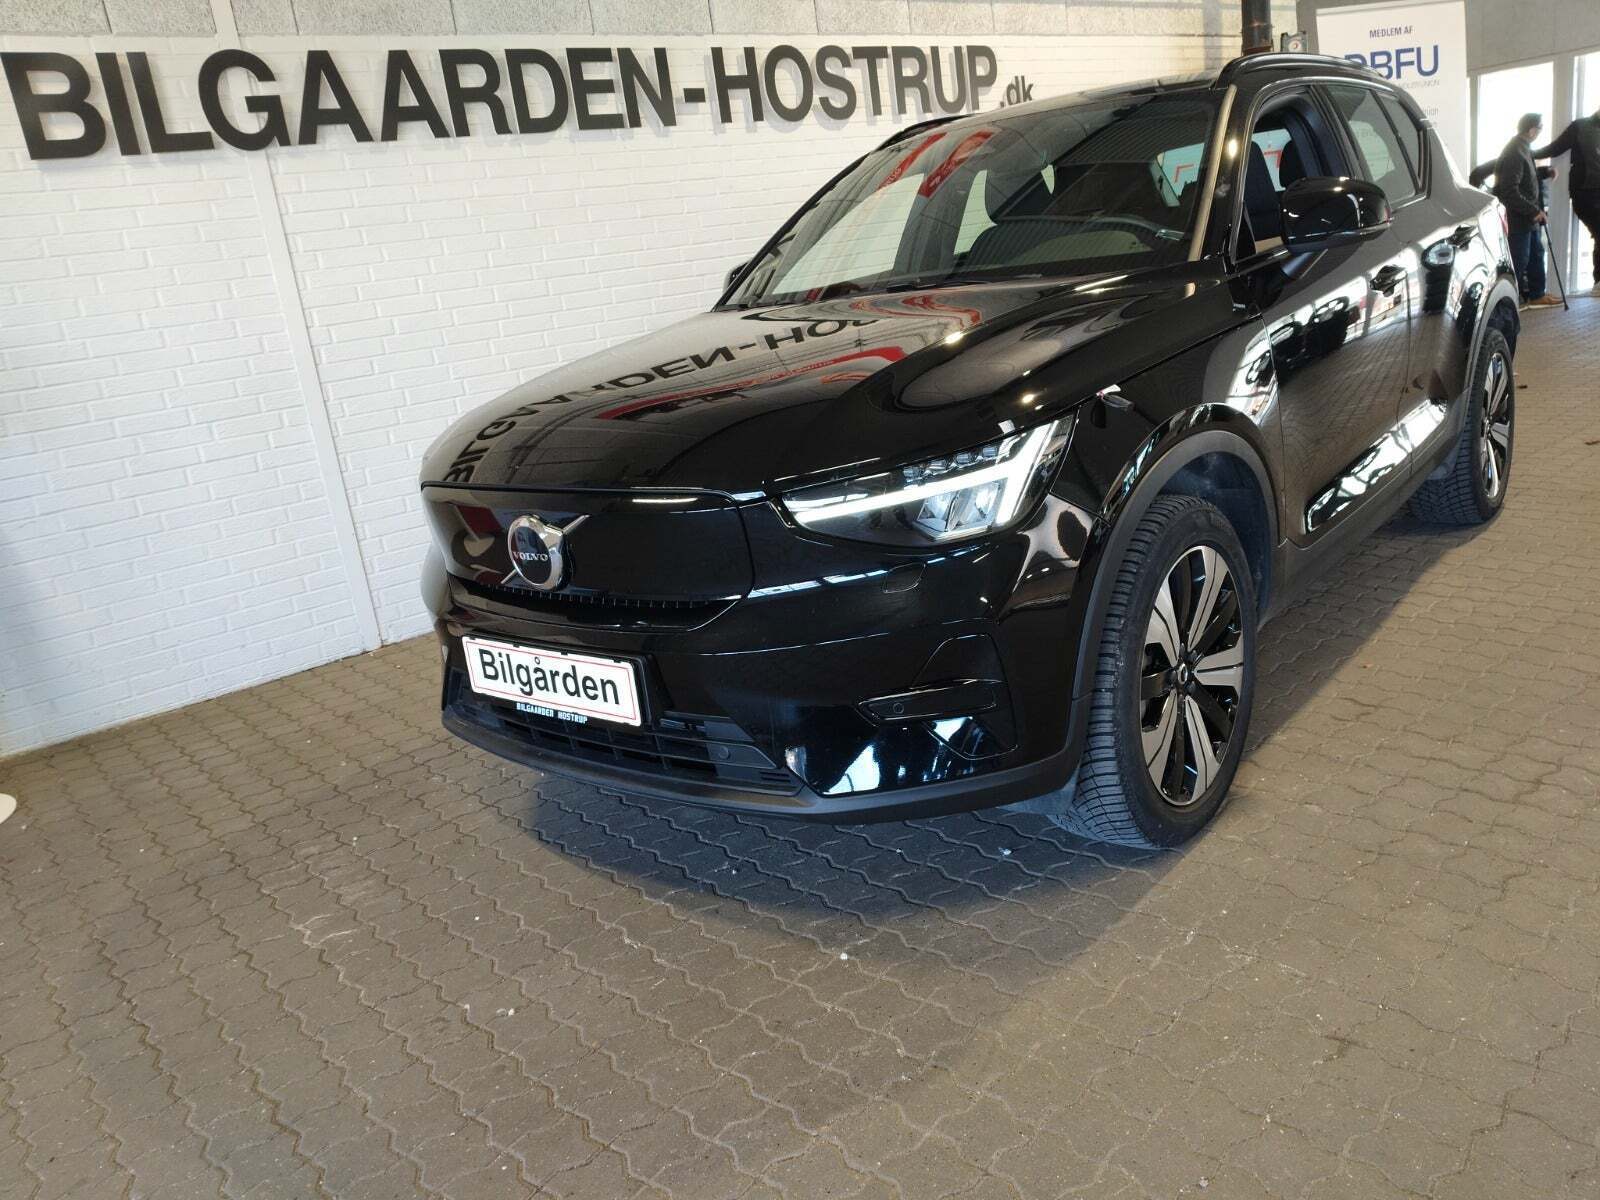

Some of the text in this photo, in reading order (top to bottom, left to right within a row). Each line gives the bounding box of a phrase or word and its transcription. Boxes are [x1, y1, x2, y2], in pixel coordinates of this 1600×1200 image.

[1369, 25, 1414, 39] MEDLEM AF
[512, 551, 549, 562] VOLVO
[478, 648, 620, 705] Bilgården
[516, 702, 588, 724] BILGAARDEN HOSTRUP
